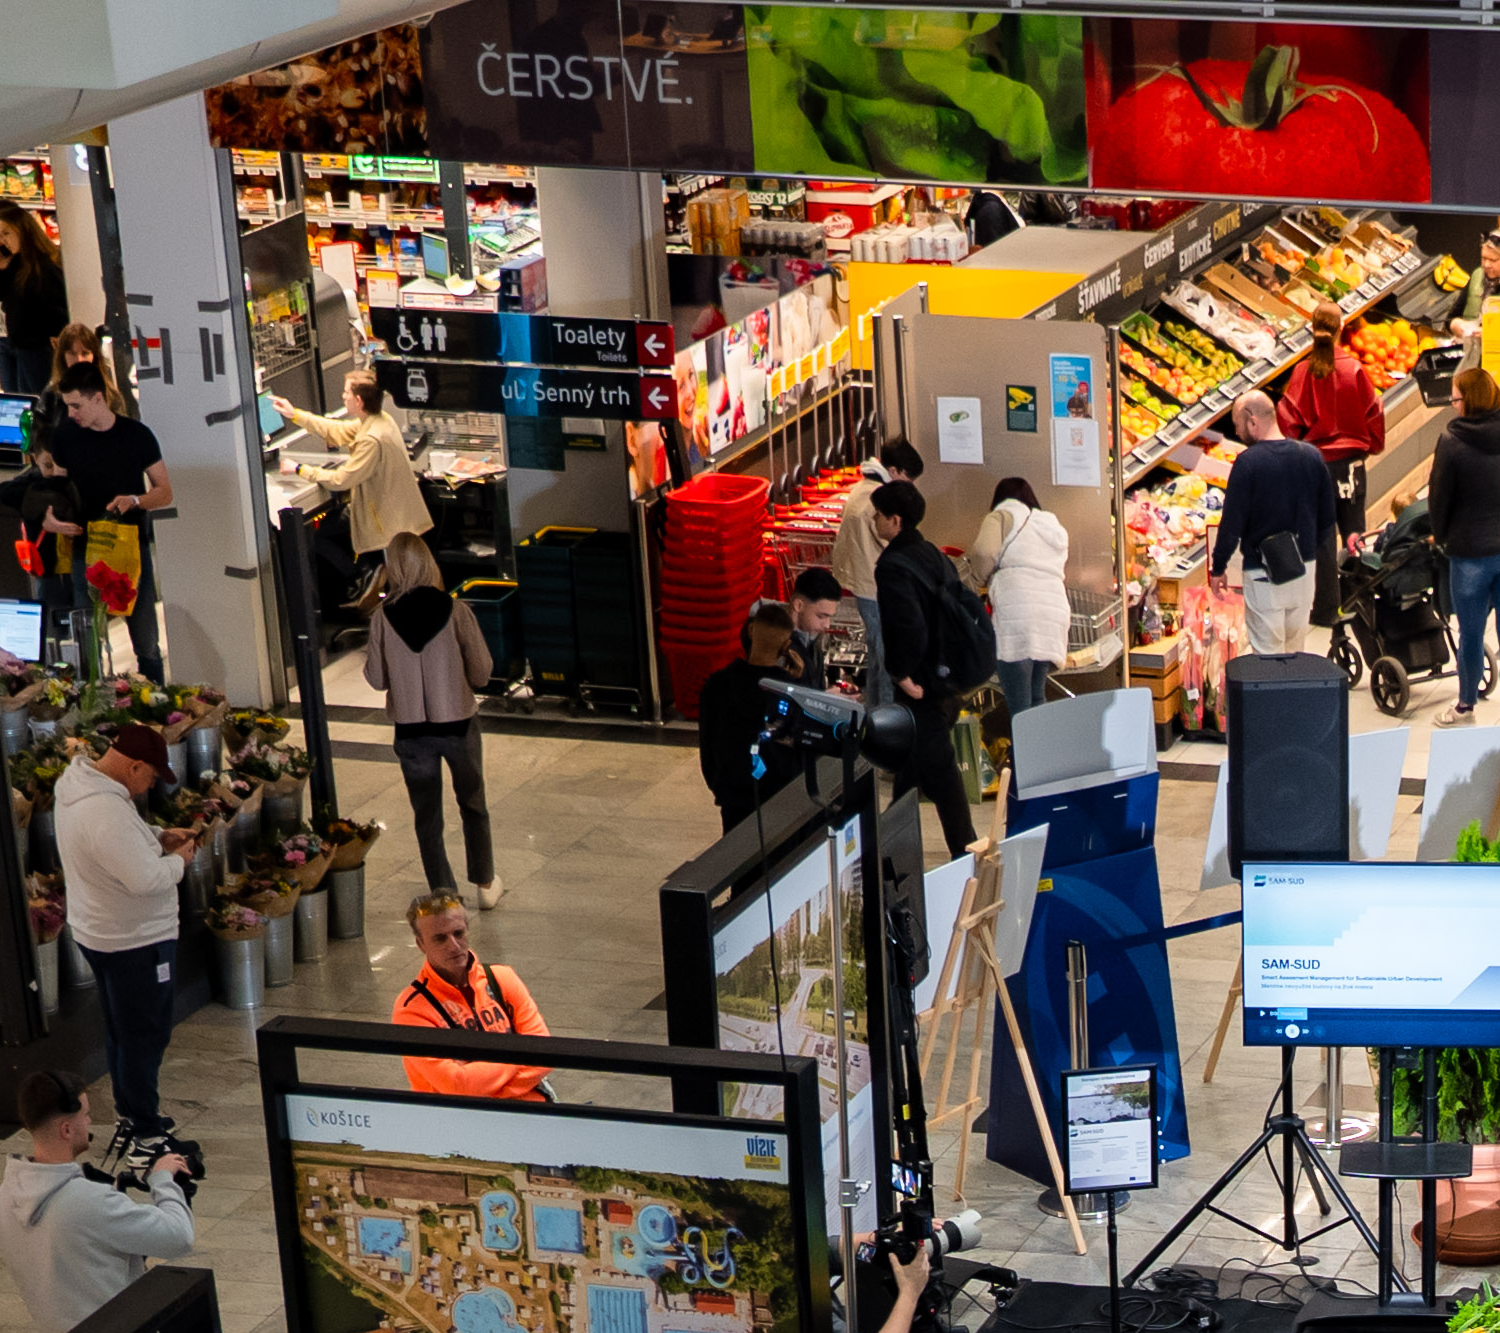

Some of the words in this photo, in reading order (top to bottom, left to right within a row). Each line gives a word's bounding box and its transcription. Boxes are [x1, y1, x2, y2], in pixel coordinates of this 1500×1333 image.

[477, 43, 693, 105] ČERSTVÉ.
[553, 323, 627, 350] Toalety
[597, 351, 628, 363] Toilets
[533, 382, 594, 406] Senný
[600, 386, 630, 405] trh
[1261, 958, 1321, 971] SAM-SUD
[320, 1108, 371, 1129] KOŠICE
